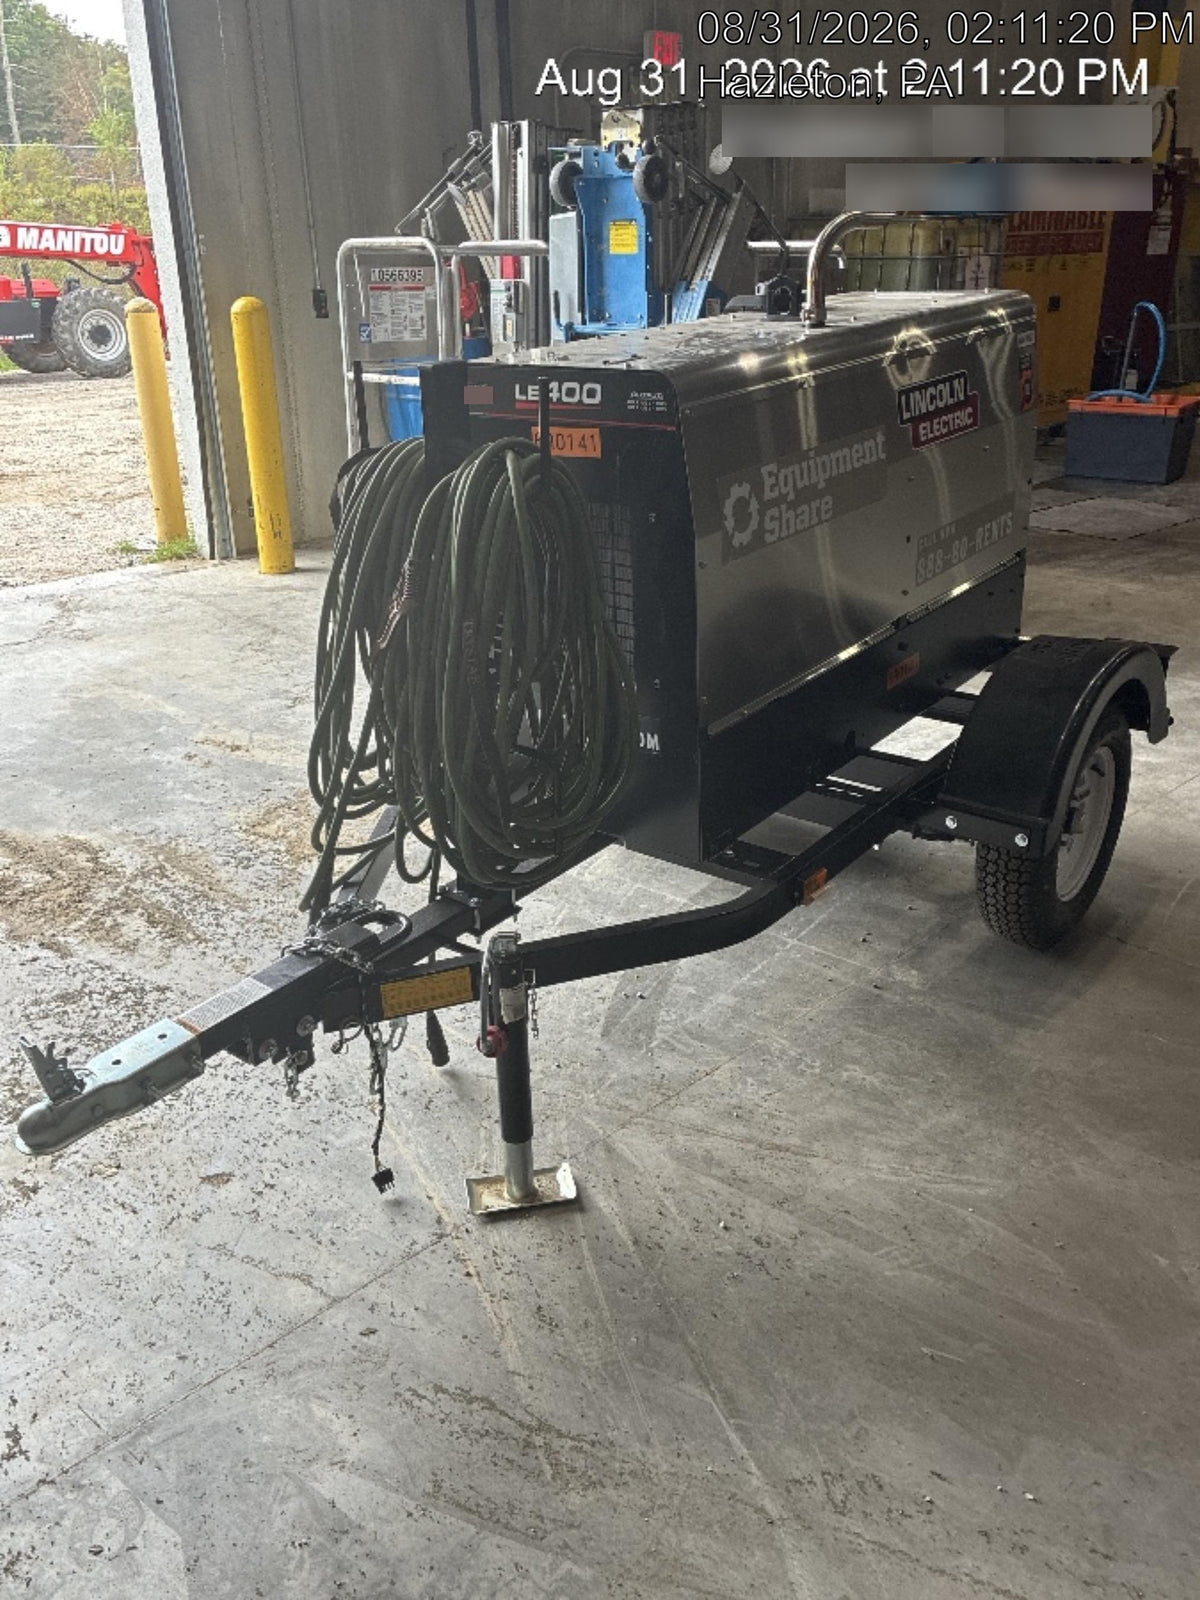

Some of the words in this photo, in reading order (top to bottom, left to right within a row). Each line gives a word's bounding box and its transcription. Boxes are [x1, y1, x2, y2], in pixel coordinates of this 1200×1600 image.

[17, 227, 125, 255] MANITOU
[900, 376, 967, 419] LINCOLN
[918, 405, 974, 442] ELECTRIC
[760, 431, 887, 501] Equipment
[763, 494, 834, 544] Share
